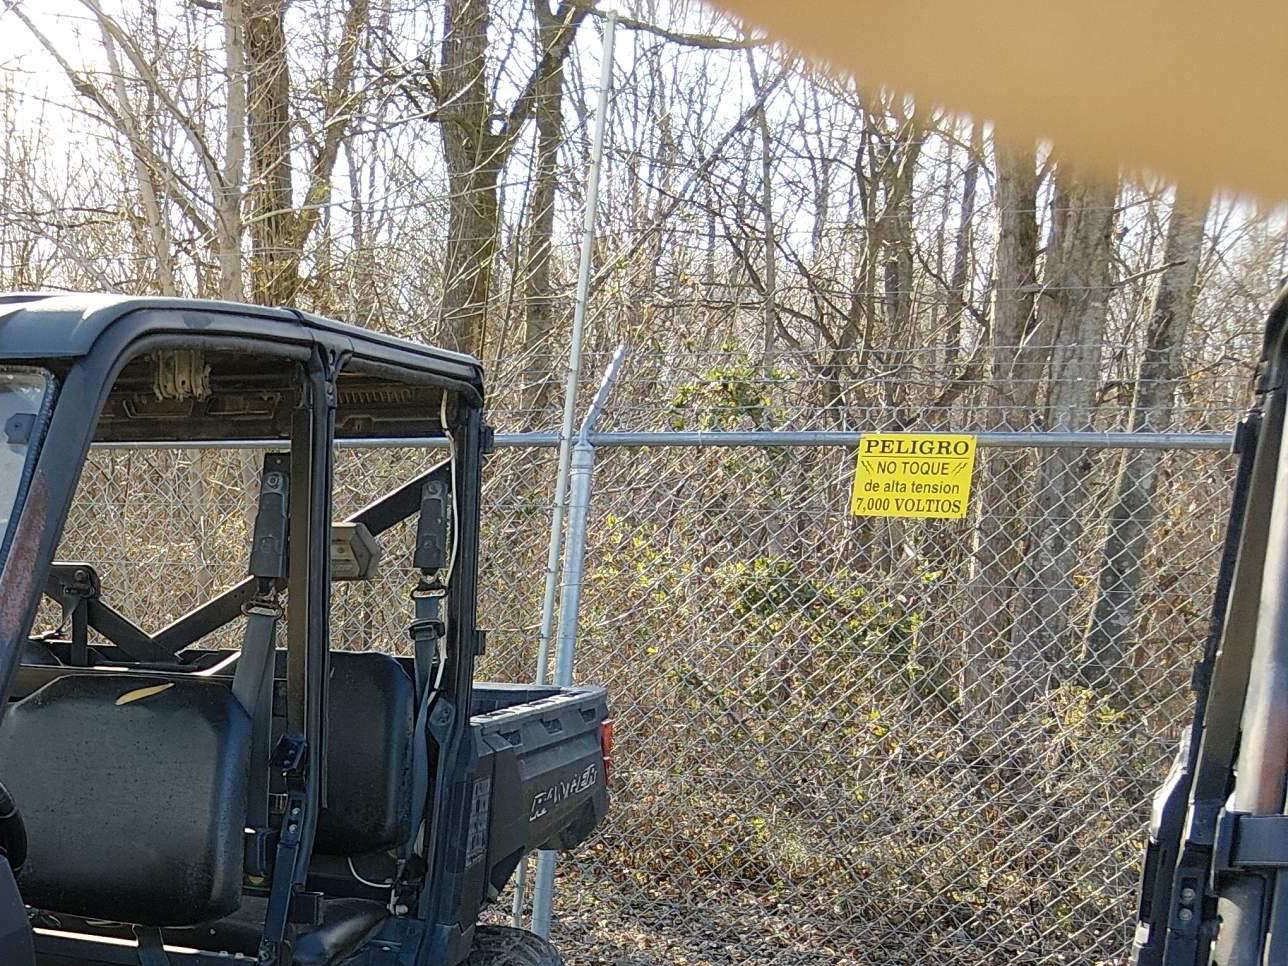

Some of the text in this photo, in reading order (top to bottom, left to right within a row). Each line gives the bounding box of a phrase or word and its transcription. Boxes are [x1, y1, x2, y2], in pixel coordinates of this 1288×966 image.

[864, 439, 970, 456] PELIGRO
[876, 460, 951, 476] NO TOQUE
[864, 479, 960, 494] de alta tension
[856, 497, 962, 514] 7,000 VOLTIOS
